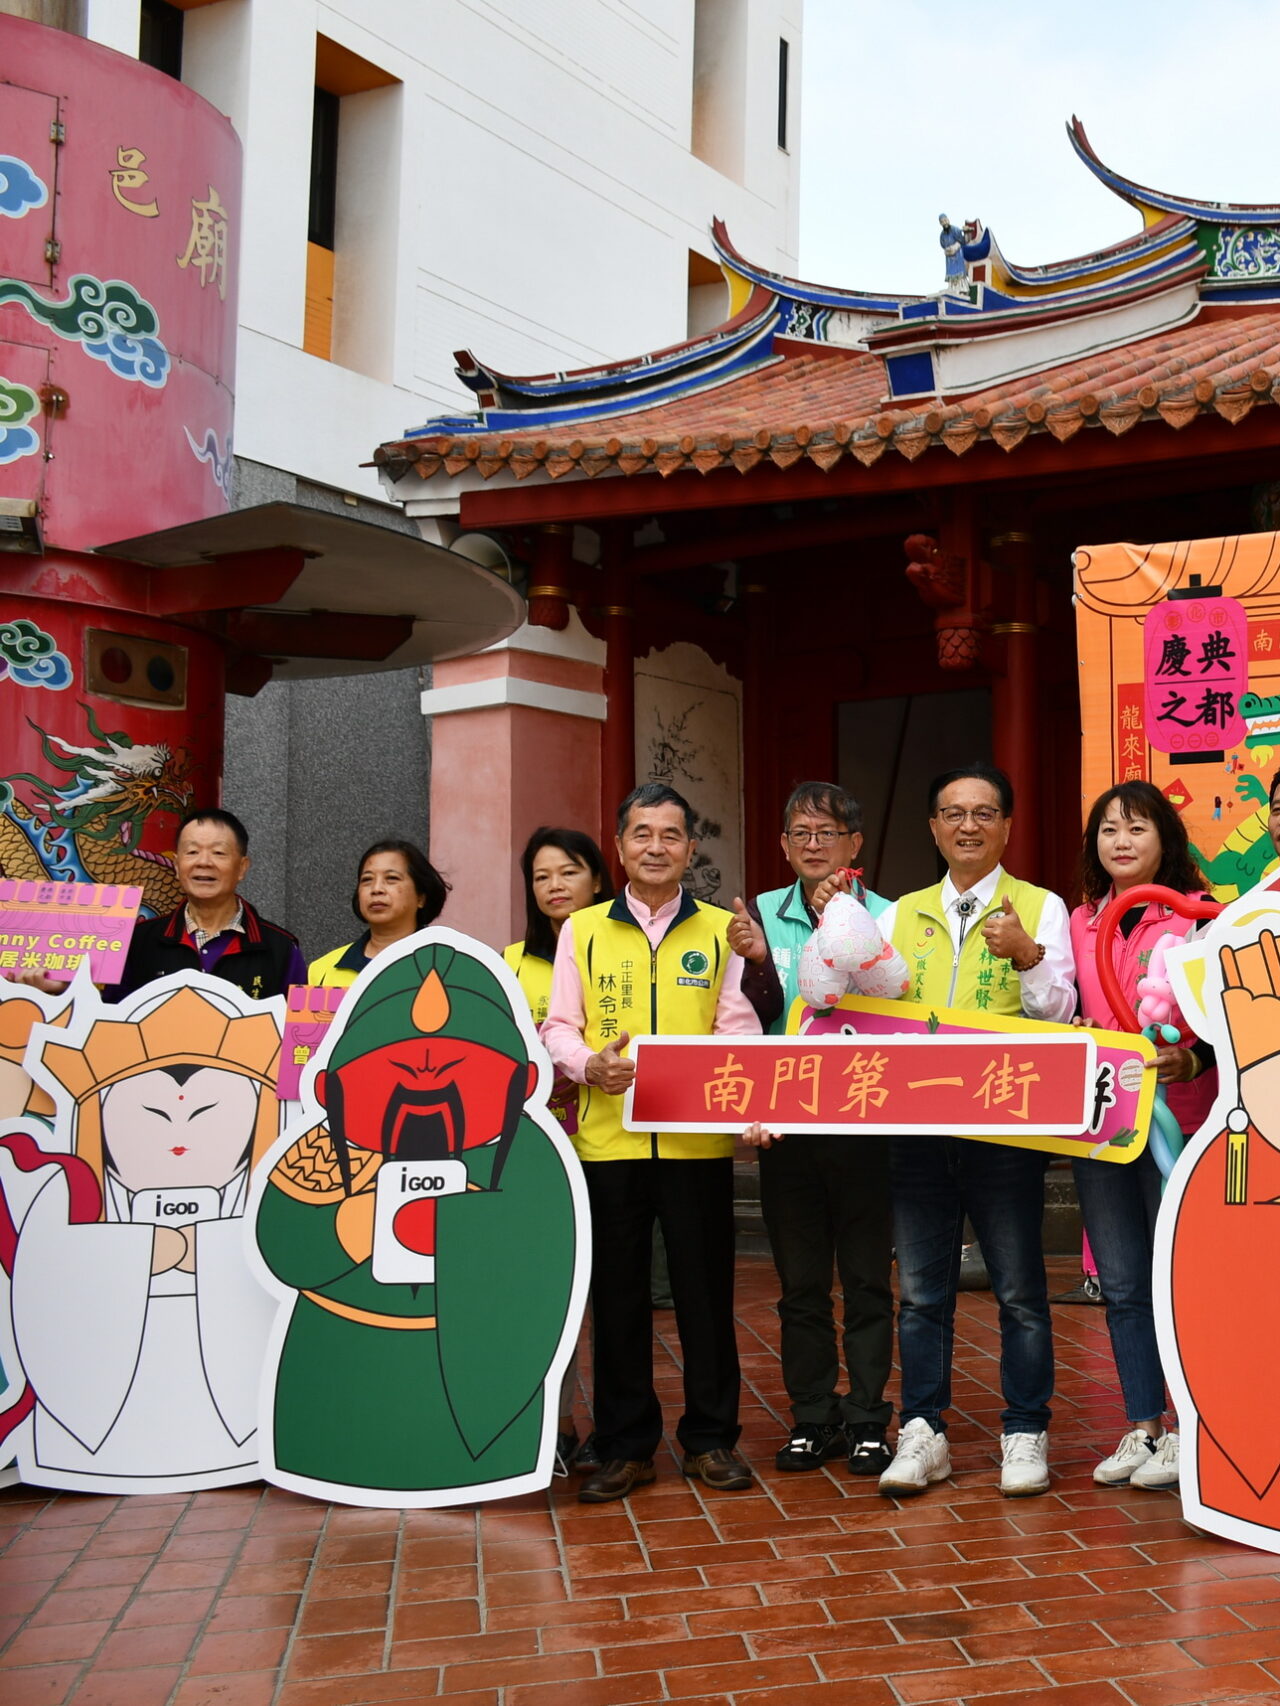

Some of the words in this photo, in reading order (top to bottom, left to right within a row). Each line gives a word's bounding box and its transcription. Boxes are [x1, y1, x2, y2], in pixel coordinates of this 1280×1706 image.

[1155, 630, 1236, 677] 慶典
[1156, 688, 1235, 730] 之都
[48, 934, 122, 952] Coffee
[621, 959, 633, 1009] 中正里長
[1000, 957, 1013, 991] 市長
[597, 973, 618, 1038] 林令宗
[703, 1050, 1041, 1120] 南門第一街
